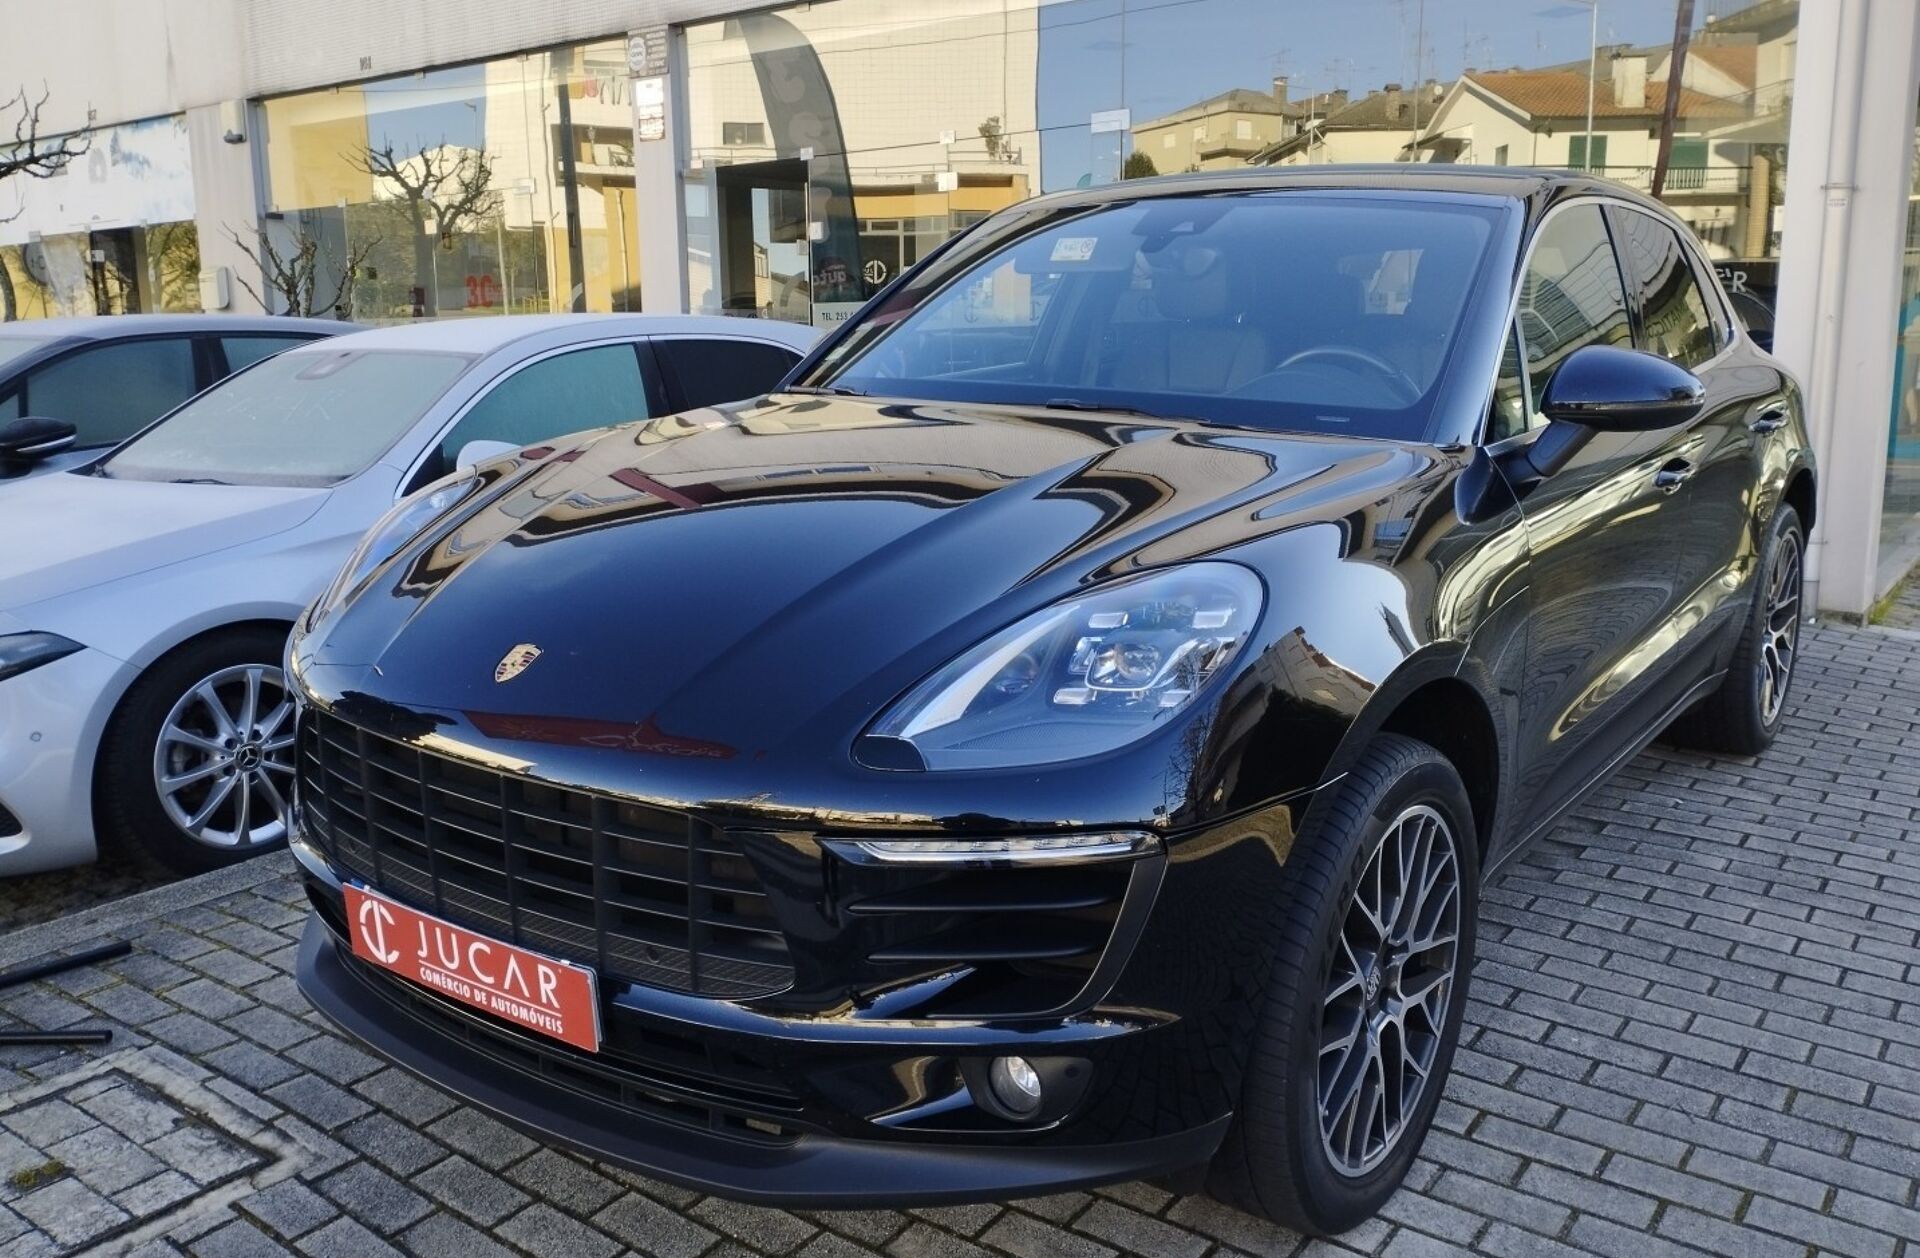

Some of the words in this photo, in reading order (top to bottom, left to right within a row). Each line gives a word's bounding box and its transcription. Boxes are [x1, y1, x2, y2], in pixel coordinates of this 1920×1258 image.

[417, 920, 561, 1009] JUCAR
[419, 966, 471, 998] COMÉRCIO
[473, 990, 487, 1005] DE
[490, 994, 564, 1034] AUTOMÓVEIS
